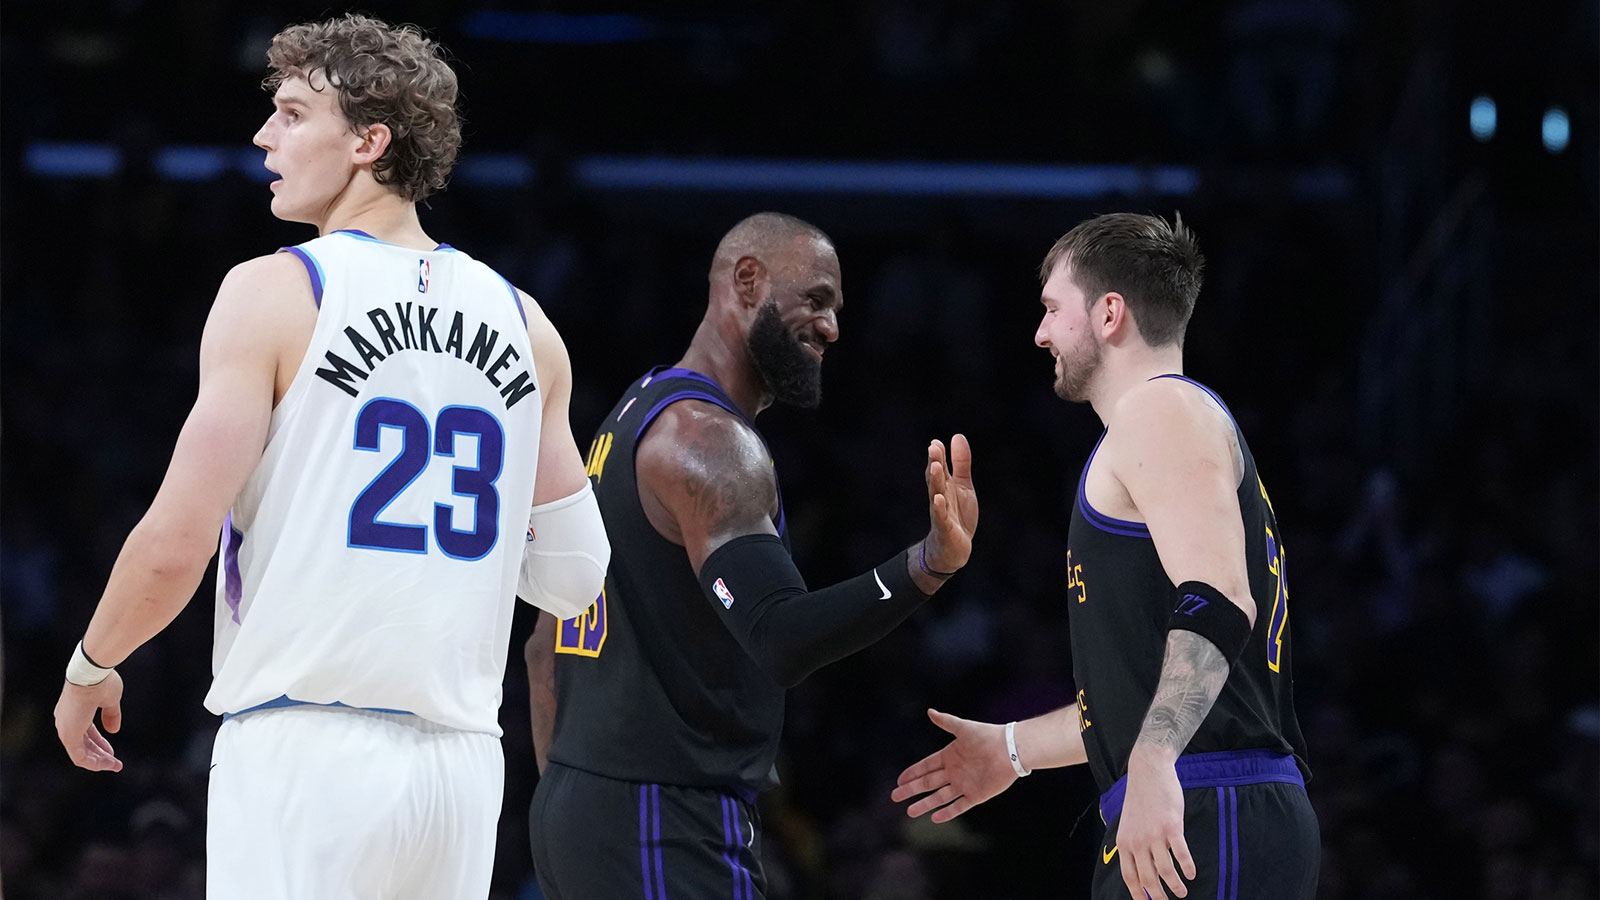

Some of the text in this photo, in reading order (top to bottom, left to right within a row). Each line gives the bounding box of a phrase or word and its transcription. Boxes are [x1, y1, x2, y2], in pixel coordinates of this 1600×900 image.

[315, 301, 536, 411] MARKKANEN
[346, 396, 506, 562] 23
[1174, 593, 1209, 616] 77
